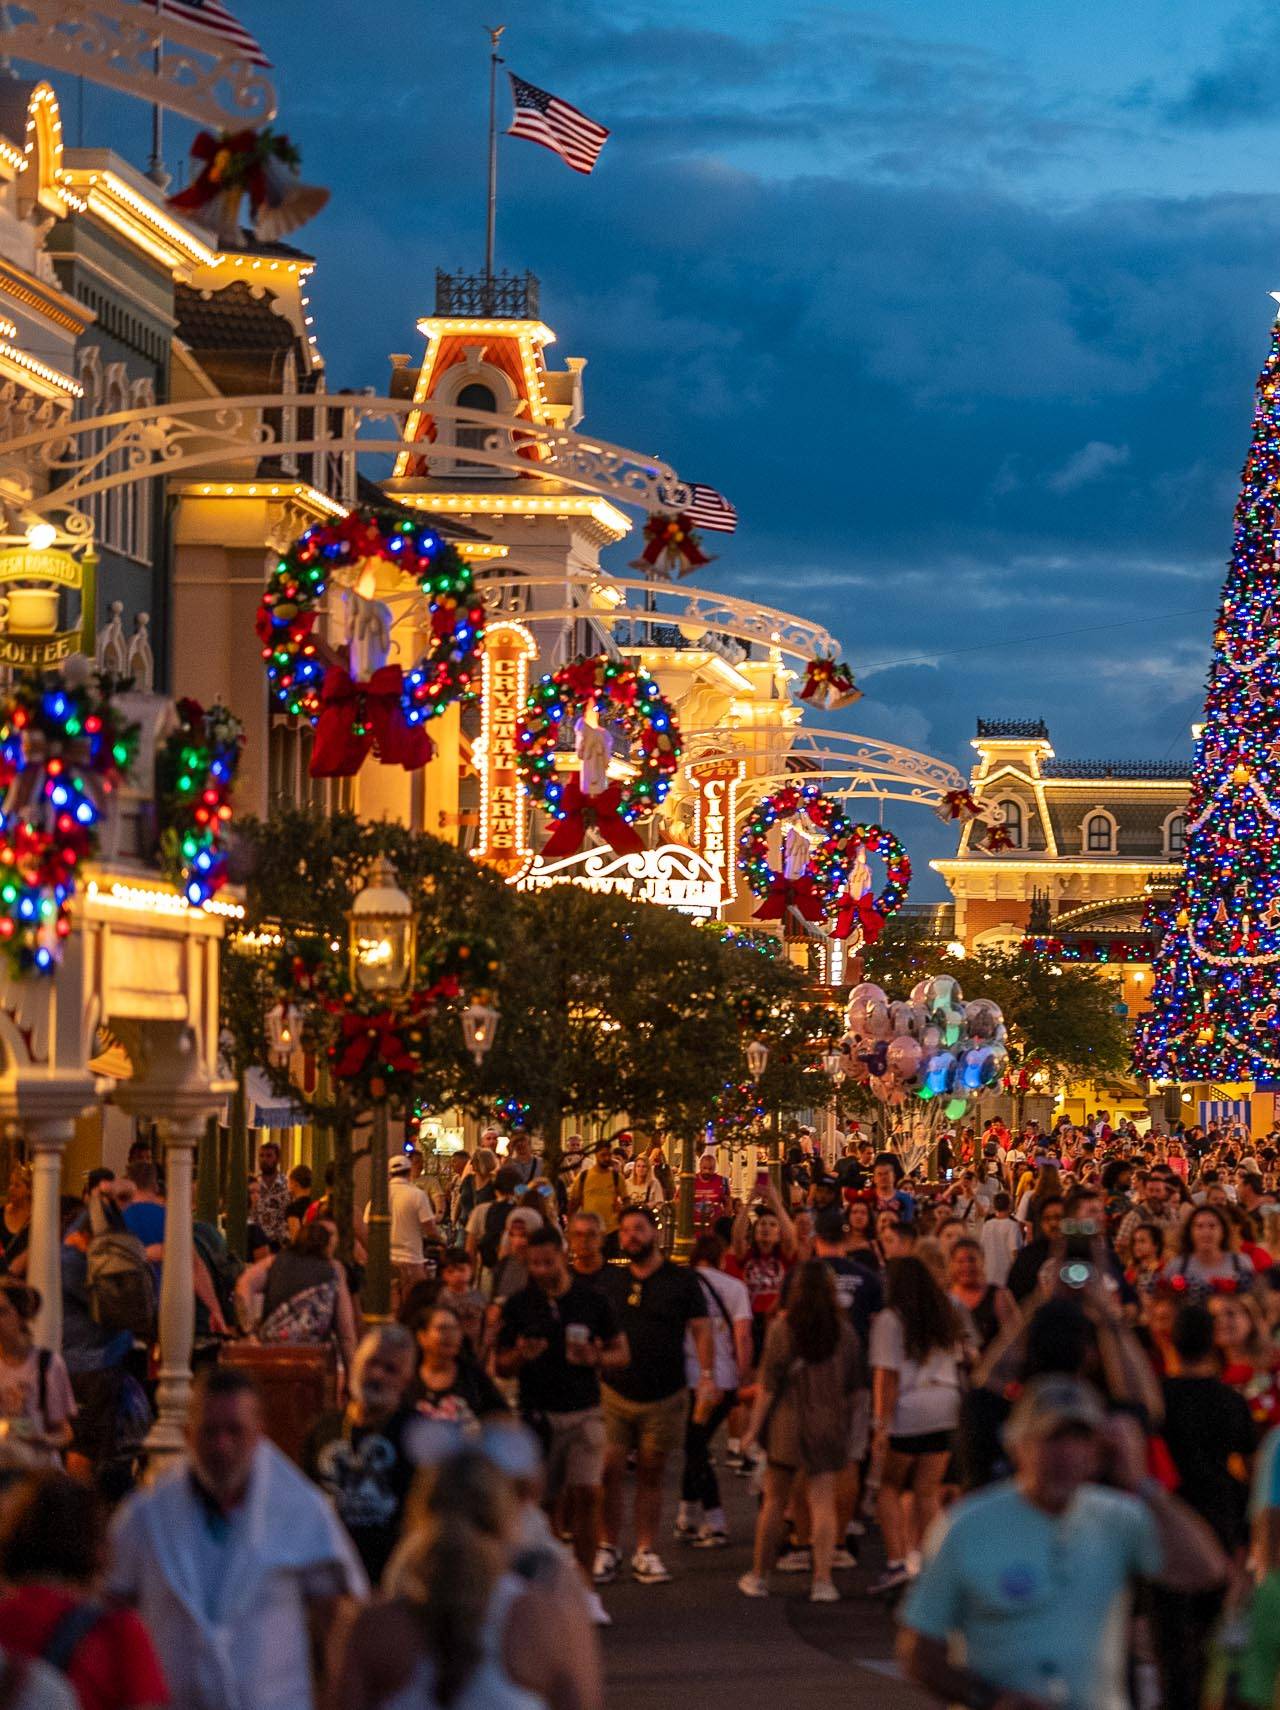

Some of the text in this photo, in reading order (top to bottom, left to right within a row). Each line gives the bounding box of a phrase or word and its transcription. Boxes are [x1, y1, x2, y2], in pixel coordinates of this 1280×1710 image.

[492, 659, 517, 770] CRYSTAL
[490, 785, 514, 849] ARTS
[702, 779, 727, 885] CINEM
